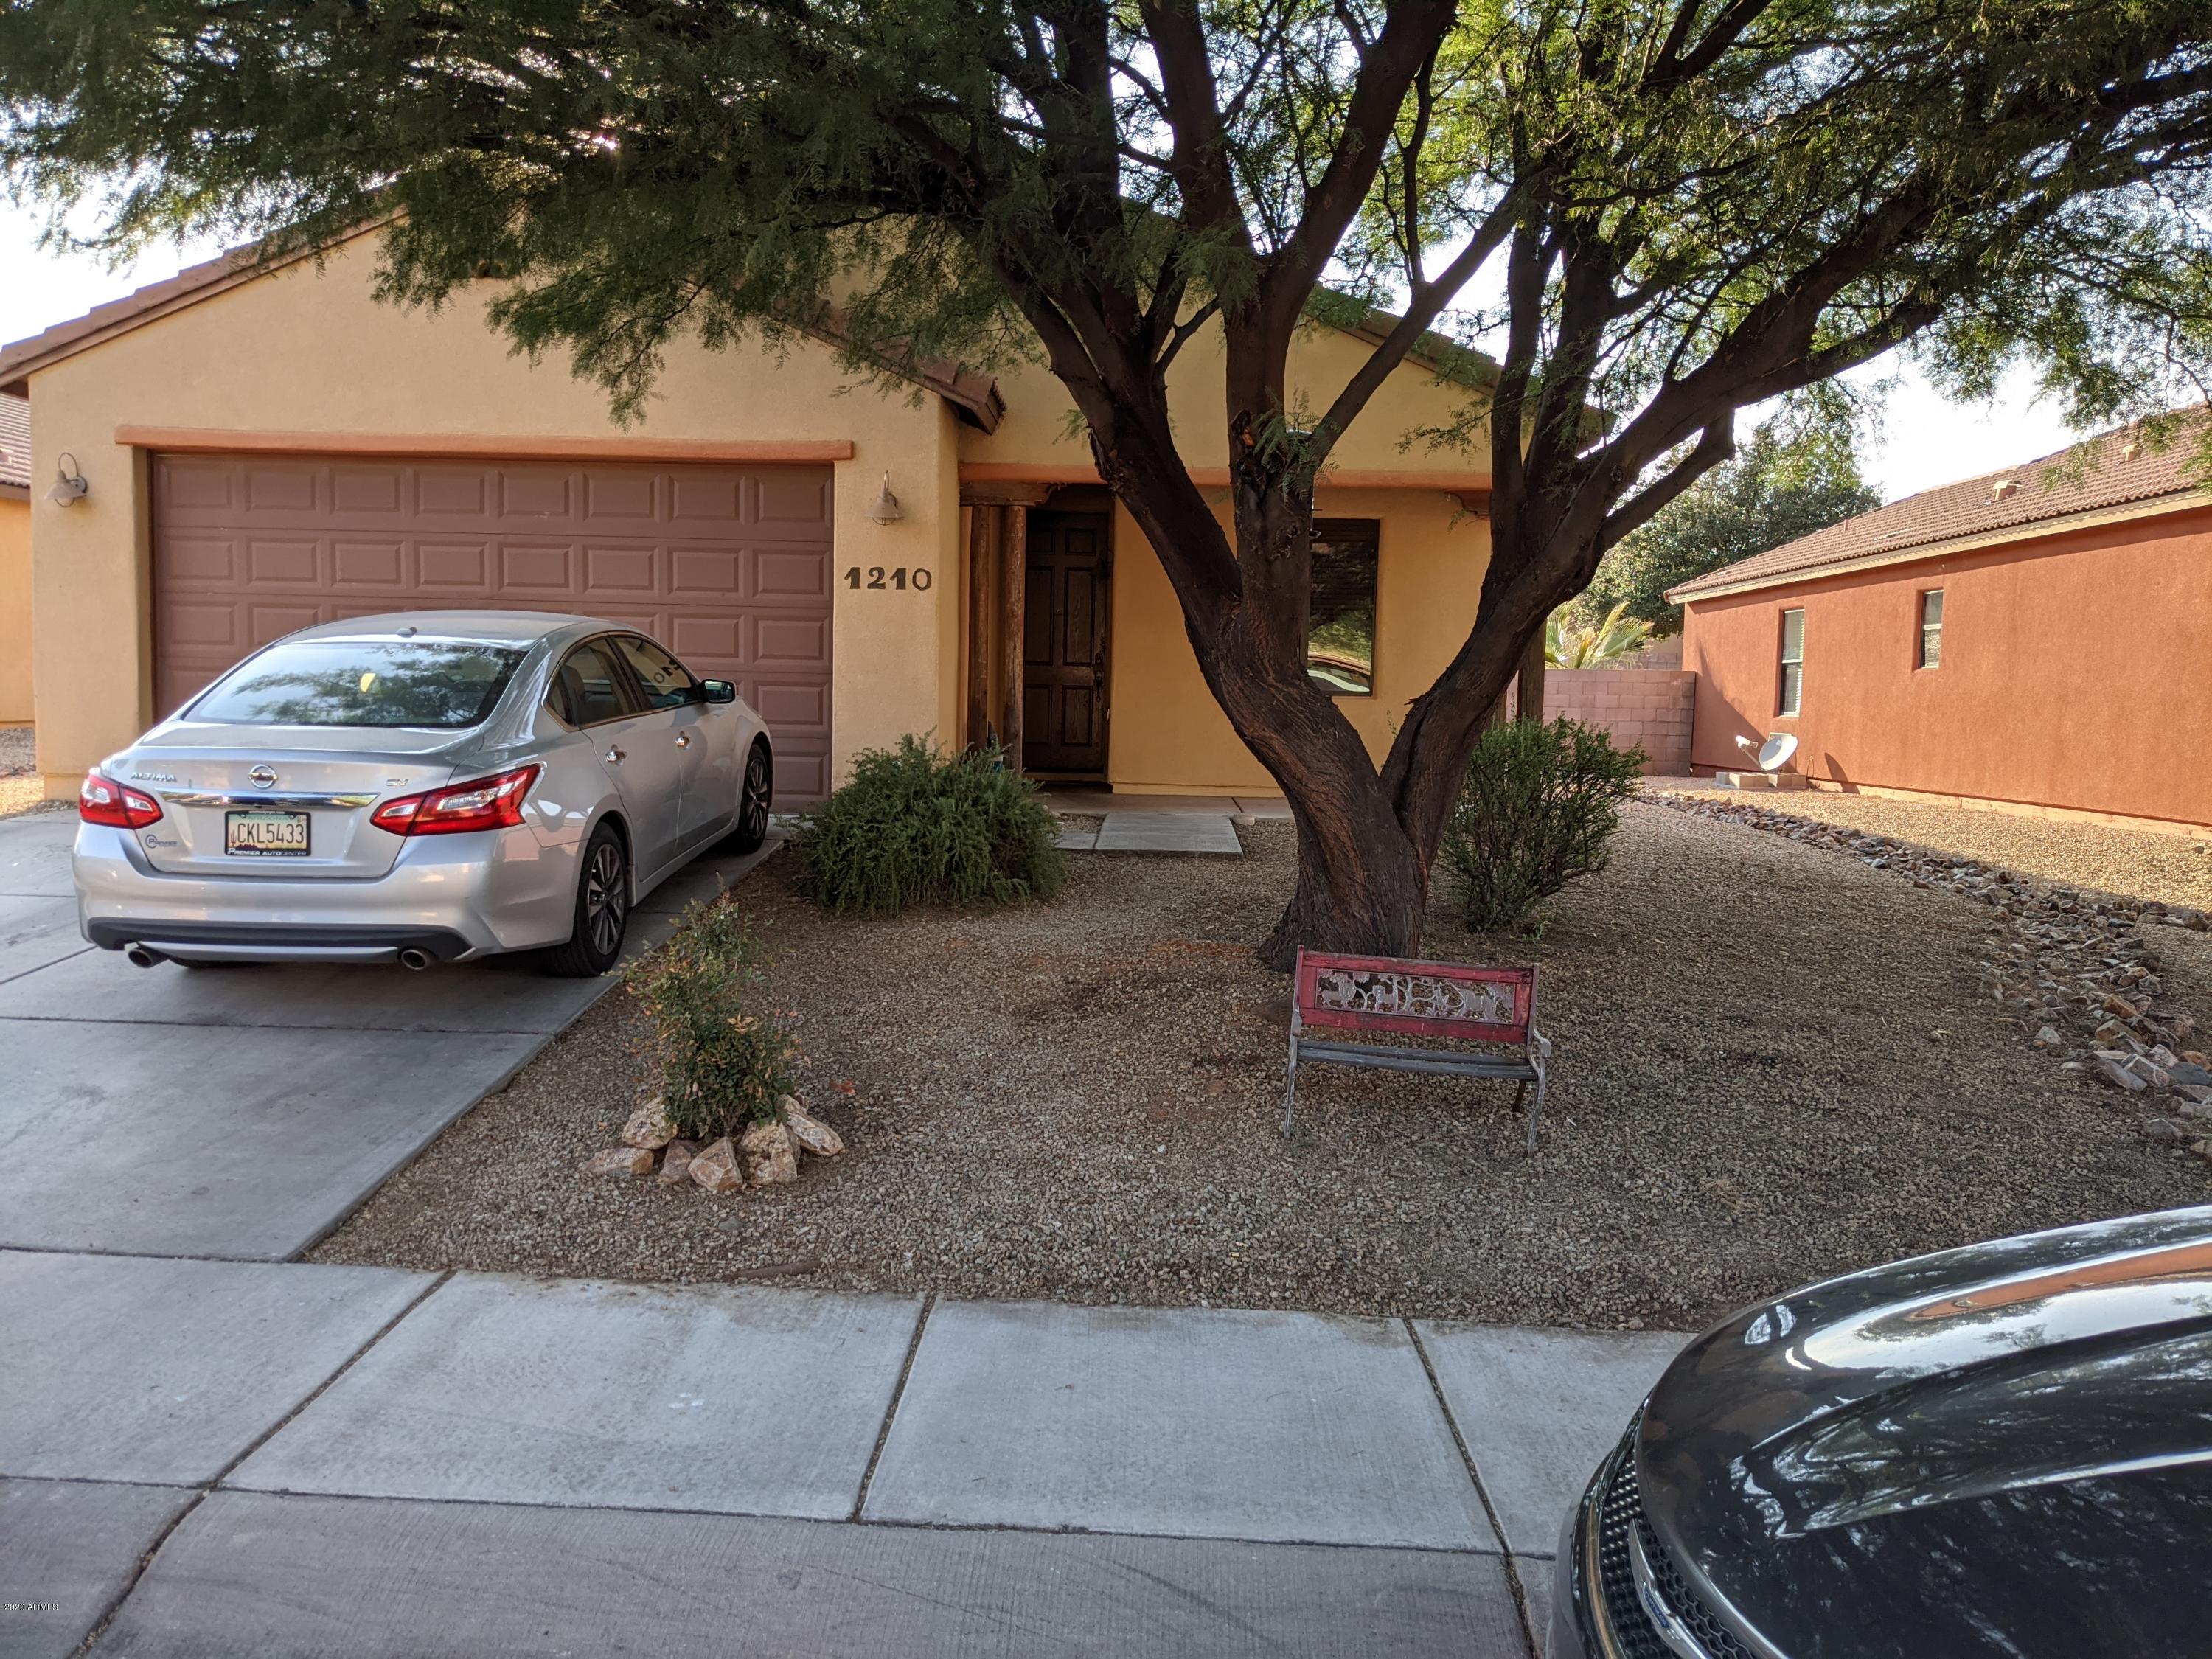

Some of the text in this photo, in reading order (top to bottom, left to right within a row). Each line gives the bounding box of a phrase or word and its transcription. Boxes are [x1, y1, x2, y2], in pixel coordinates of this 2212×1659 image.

[844, 566, 932, 591] 1210
[131, 772, 177, 782] ALTIMA
[386, 779, 408, 787] SV
[237, 822, 304, 844] CKL5433
[228, 847, 260, 855] PREMIER
